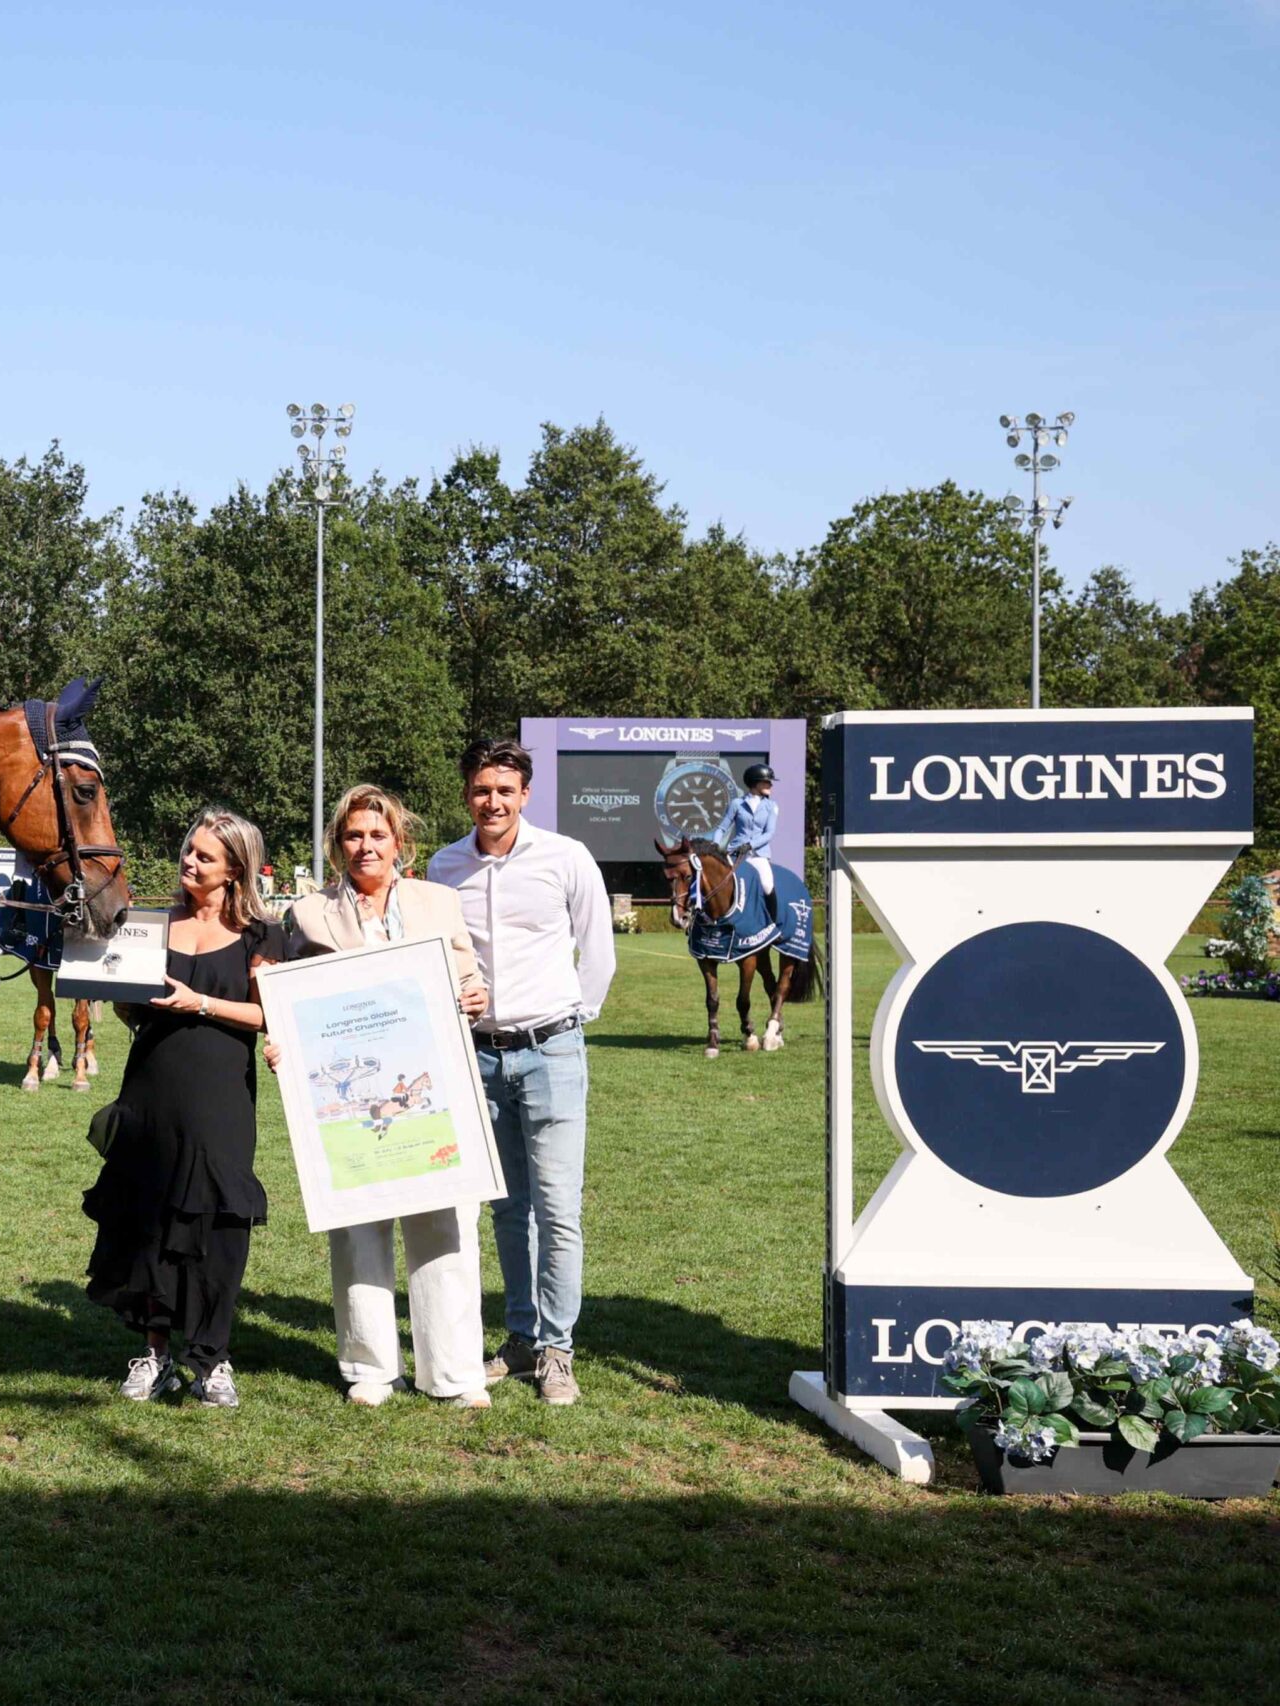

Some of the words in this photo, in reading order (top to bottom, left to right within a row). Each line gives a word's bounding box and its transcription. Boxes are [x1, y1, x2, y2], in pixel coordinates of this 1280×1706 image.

[618, 727, 713, 742] LONGINES
[870, 753, 1227, 801] LONGINES
[571, 794, 640, 805] LONGINES
[118, 928, 149, 938] INES
[321, 1027, 353, 1038] Future
[354, 1017, 407, 1031] Champions
[326, 1016, 369, 1029] Longines
[370, 1009, 398, 1020] Global
